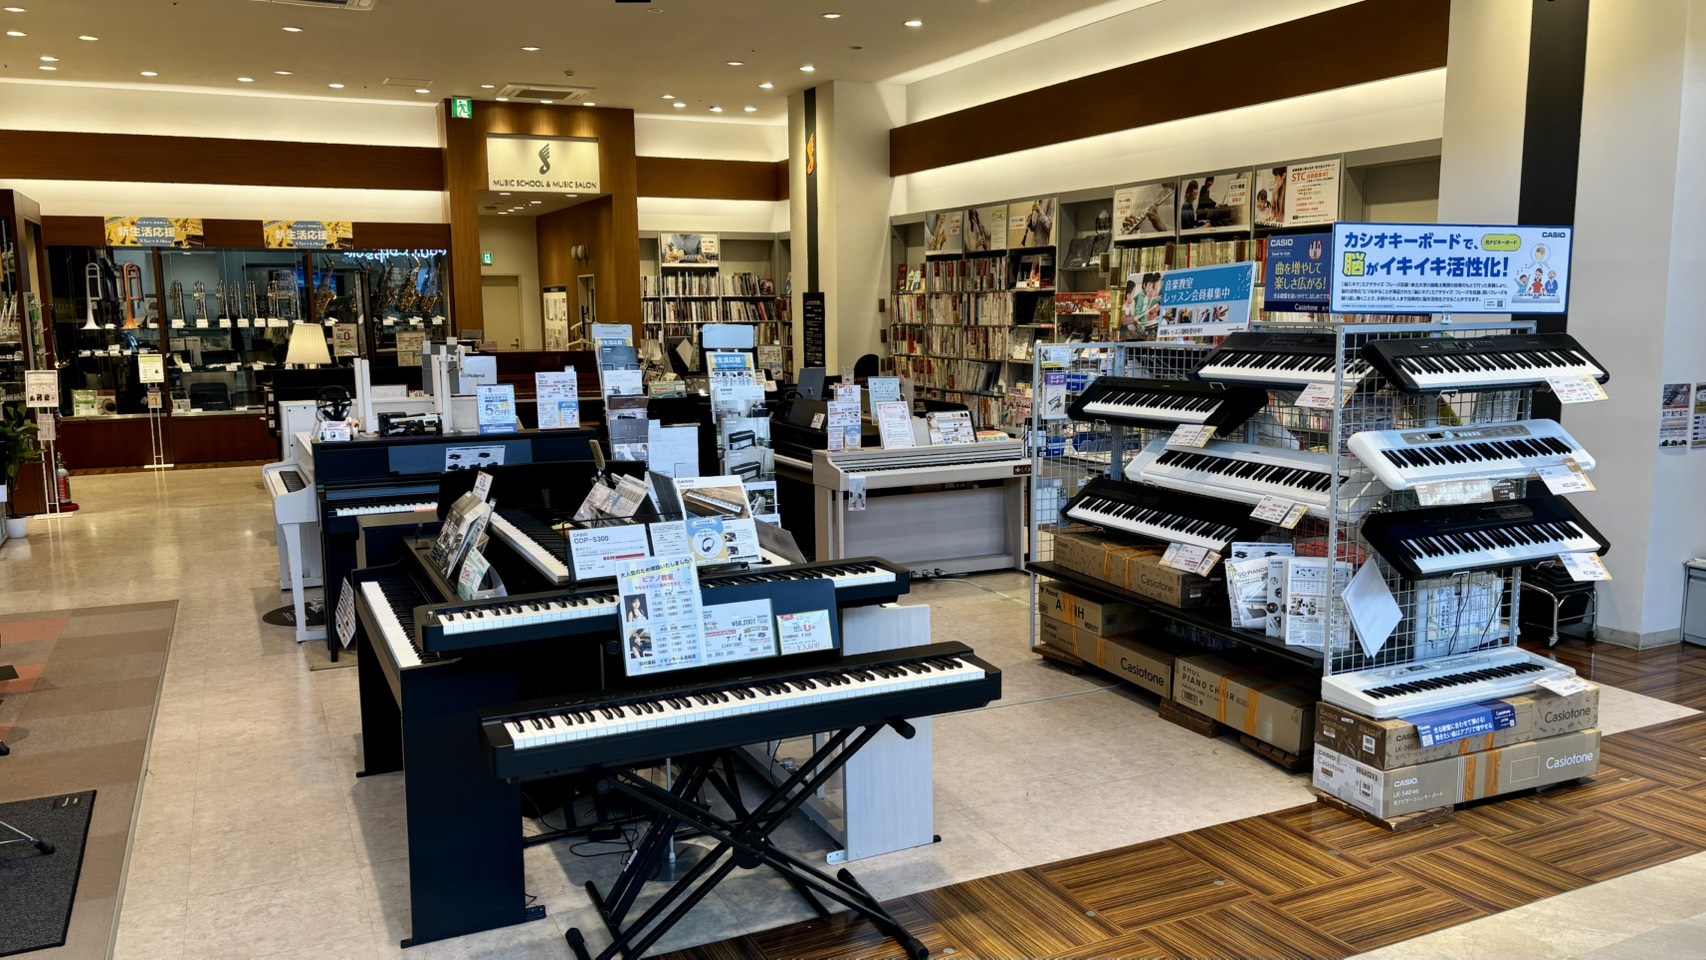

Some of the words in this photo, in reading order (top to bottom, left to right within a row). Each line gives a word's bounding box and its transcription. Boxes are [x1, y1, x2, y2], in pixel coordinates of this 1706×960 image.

[1292, 172, 1306, 182] STC
[516, 180, 544, 188] SCHOOL
[552, 181, 574, 189] MUSIC
[118, 226, 176, 238] 新生活応援
[275, 229, 328, 241] 新生活応援
[1270, 238, 1294, 247] CASIO
[1344, 232, 1478, 250] カシオキーボードで、
[1275, 260, 1321, 275] 曲を増やして
[1164, 277, 1194, 292] 音楽教室
[1274, 276, 1326, 290] 楽しさ広がる!
[1164, 286, 1230, 303] レッスン会員募集中
[574, 536, 608, 544] CDP-S300
[642, 574, 674, 582] ピアノ教室
[1140, 573, 1174, 594] Casiotone
[1120, 656, 1164, 687] Casiotone
[1182, 666, 1200, 678] EMUL
[1182, 673, 1207, 690] PIANO
[1208, 684, 1234, 700] CHIR
[1320, 709, 1338, 720] CASIO
[1544, 706, 1591, 725] Casiotone
[1320, 716, 1348, 732] Casiotone
[1318, 749, 1336, 760] CASIO
[1546, 751, 1594, 770] Casiotone
[1318, 757, 1344, 774] Casiotone
[1394, 778, 1418, 788] CASIO
